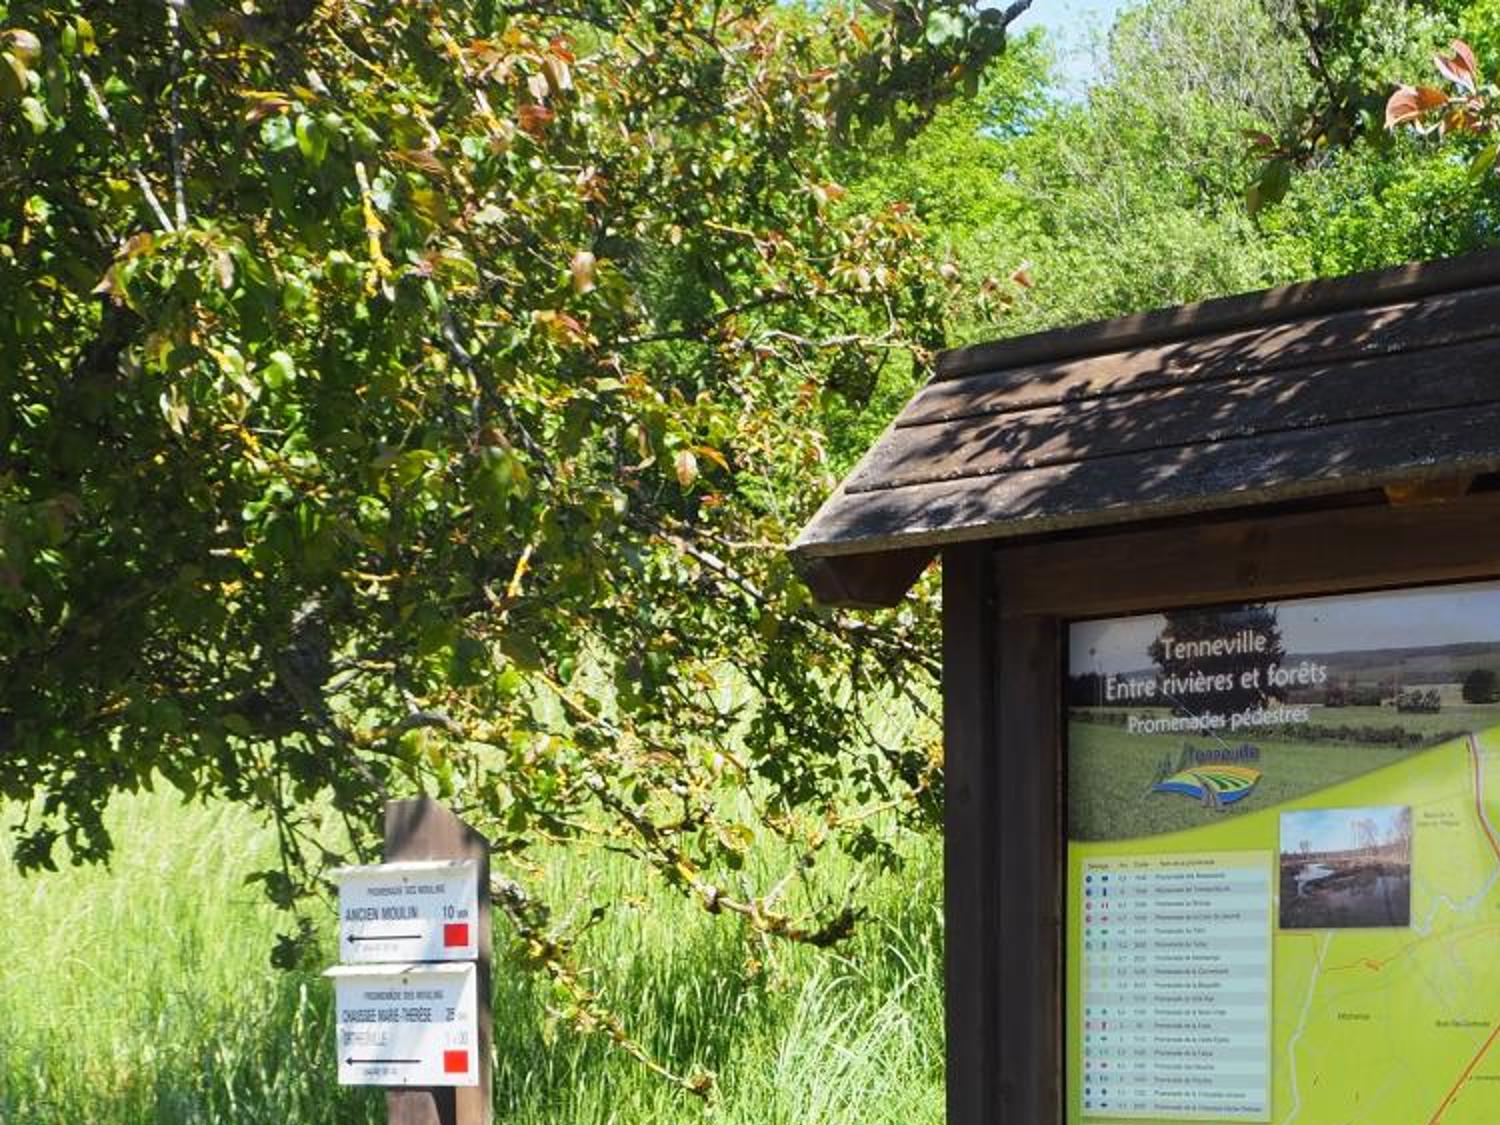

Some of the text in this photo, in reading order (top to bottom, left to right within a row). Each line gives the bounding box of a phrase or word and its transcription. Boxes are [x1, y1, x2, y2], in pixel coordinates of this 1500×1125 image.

[1161, 630, 1267, 660] Tenneville
[1106, 661, 1328, 700] Entre rivières et forêts
[1128, 705, 1310, 734] Promenades pédestres
[443, 904, 455, 920] 10
